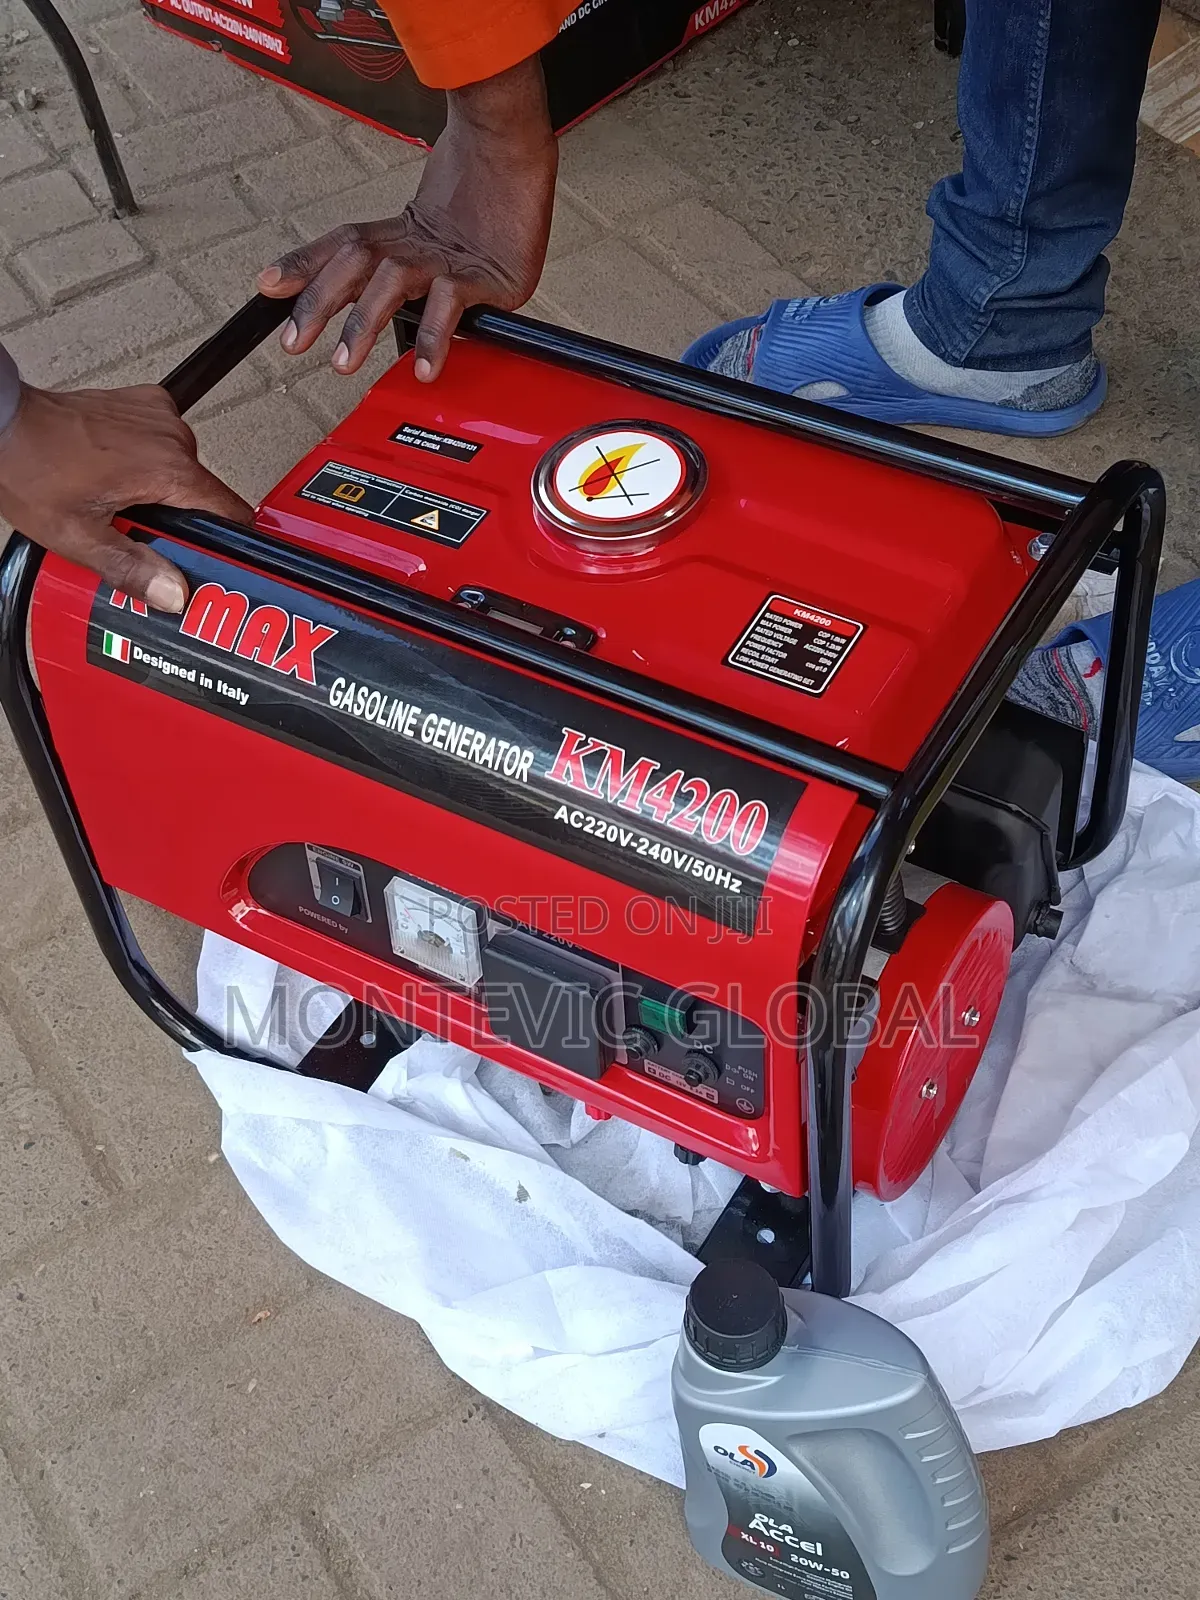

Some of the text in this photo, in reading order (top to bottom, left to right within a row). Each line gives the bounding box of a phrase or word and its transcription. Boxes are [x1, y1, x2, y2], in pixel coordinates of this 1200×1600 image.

[558, 12, 577, 34] AND
[578, 2, 591, 19] DC
[402, 426, 421, 436] Serial
[395, 433, 415, 443] MADE
[421, 440, 441, 451] CHINA
[759, 619, 793, 635] MAX POWER
[764, 612, 804, 630] RATED POWER
[793, 608, 832, 627] KM4200
[749, 633, 784, 649] FREQUENCY
[754, 626, 799, 646] RATED VOLTAGE
[740, 647, 780, 665] RECOIL START
[745, 640, 788, 660] POWER FACTOR
[132, 646, 250, 707] Designed in Italy
[735, 654, 816, 686] LOW-POWER GENERATING SET
[328, 676, 534, 783] GASOLINE GENERATOR
[544, 725, 770, 858] KM4200
[553, 804, 743, 894] AC220V-240V/50Hz
[298, 905, 349, 934] POWERED by
[693, 1039, 714, 1054] DC
[658, 1071, 672, 1081] DC
[737, 1065, 759, 1079] PUSH
[742, 1072, 755, 1082] ON
[740, 1084, 755, 1094] OFF
[713, 1445, 756, 1471] OLA
[754, 1512, 794, 1535] OLA
[740, 1531, 775, 1553] XL 10
[790, 1553, 850, 1580] 20W-50
